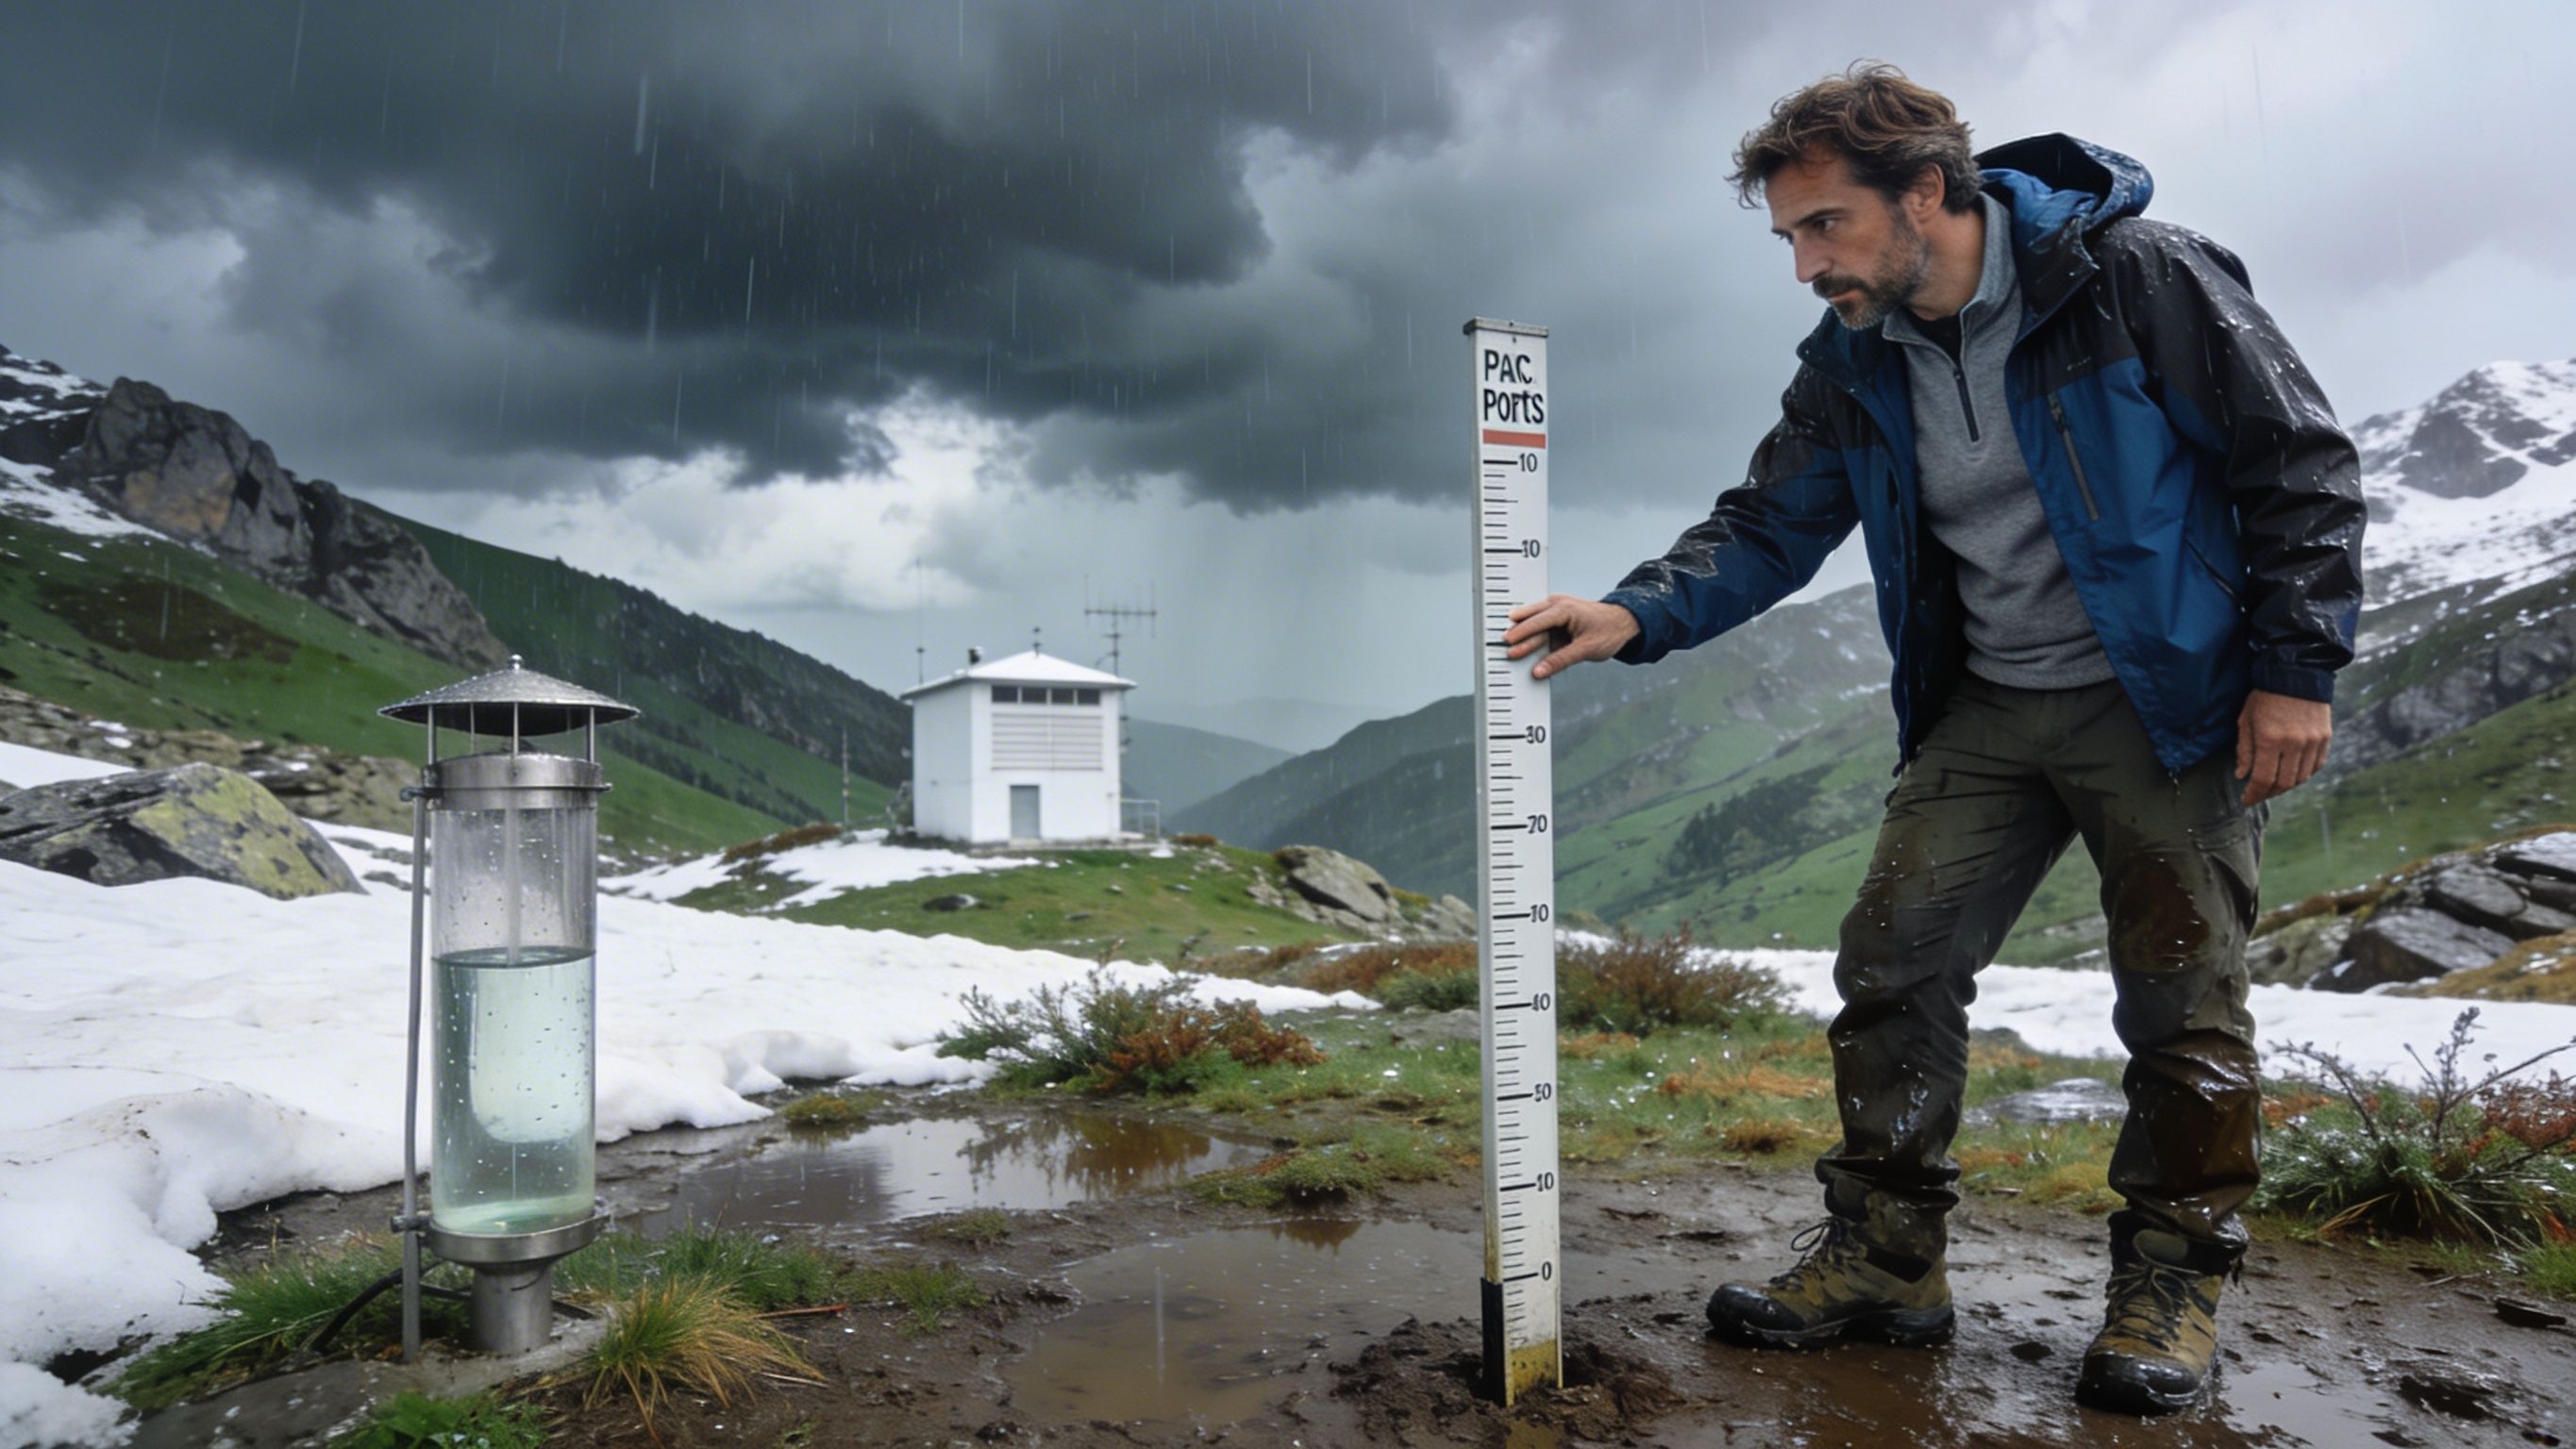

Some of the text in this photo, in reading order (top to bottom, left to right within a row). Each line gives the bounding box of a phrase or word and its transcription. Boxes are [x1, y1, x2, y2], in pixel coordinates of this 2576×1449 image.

[1484, 349, 1532, 384] PAC
[1519, 453, 1538, 473] 10
[1531, 904, 1549, 923] 10
[1537, 1172, 1554, 1191] 10
[1542, 1261, 1552, 1281] 0
